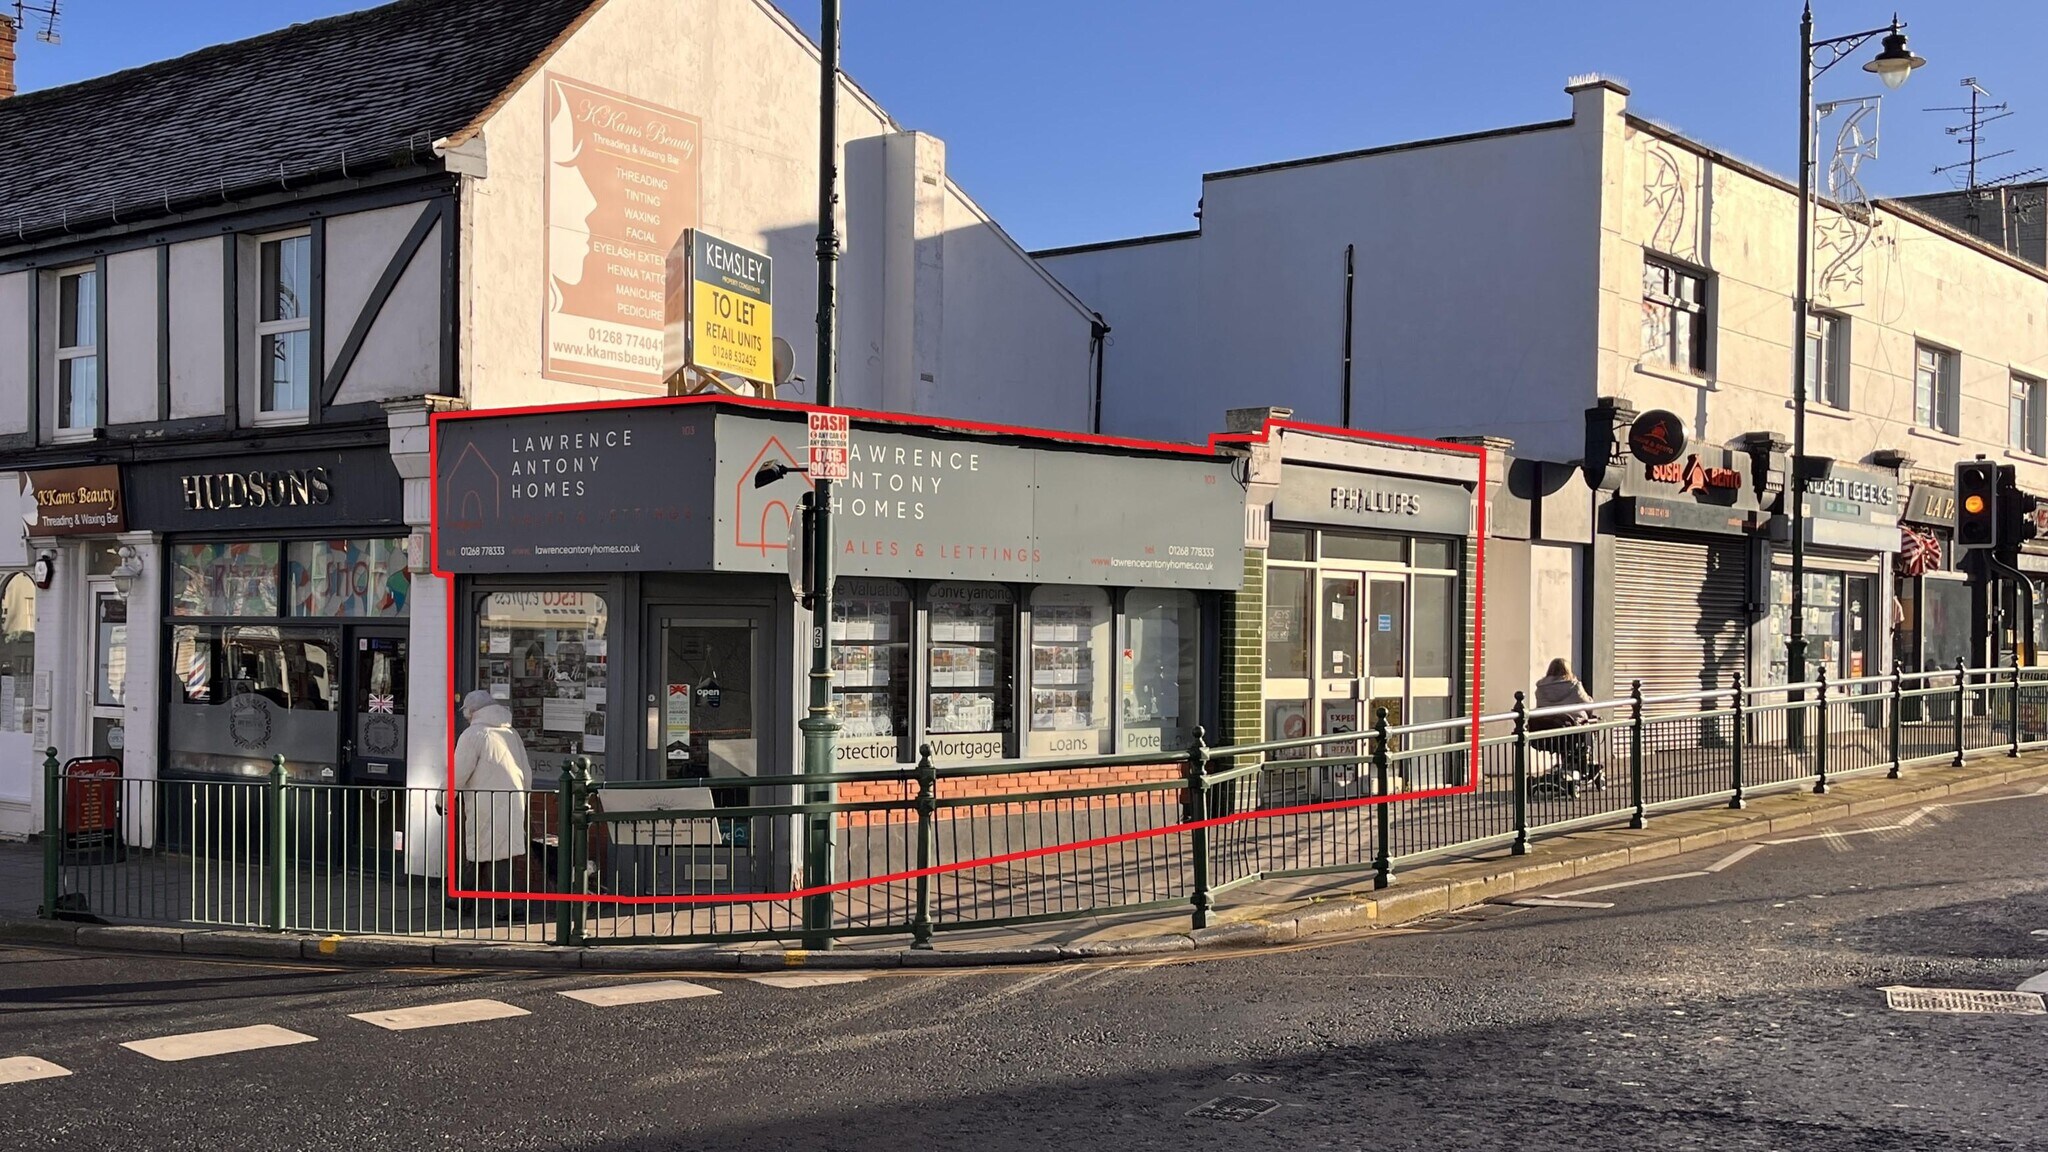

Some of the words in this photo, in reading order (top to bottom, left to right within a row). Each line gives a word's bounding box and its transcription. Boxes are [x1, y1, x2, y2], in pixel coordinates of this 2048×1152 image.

[576, 98, 642, 138] KKams
[646, 120, 694, 161] Beauty
[593, 132, 631, 153] Threading
[632, 143, 638, 153] &
[639, 146, 666, 165] Waxing
[667, 153, 679, 165] Bar
[615, 167, 669, 190] THREADING
[625, 188, 661, 207] TINTING
[624, 207, 660, 225] WAXING
[626, 227, 657, 243] FACIAL
[593, 241, 635, 260] EYELASH
[607, 263, 639, 280] HENNA
[706, 242, 763, 283] KEMSLEY
[616, 284, 663, 303] MANICURE
[617, 303, 663, 321] PEDICURE
[712, 291, 731, 318] TO
[736, 299, 755, 326] LET
[588, 327, 622, 345] 01268
[706, 321, 735, 344] RETAIL
[737, 330, 762, 352] UNITS
[712, 345, 732, 360] 01268
[734, 350, 757, 367] 532425
[810, 415, 847, 431] CASH
[511, 430, 632, 453] LAWRENCE
[815, 448, 842, 462] 07415
[849, 443, 979, 471] AWRENCE
[511, 456, 600, 476] ANTONY
[1652, 462, 1681, 482] SUSHI
[1711, 468, 1742, 489] BENTO
[181, 465, 331, 511] HUDSONS
[511, 481, 585, 499] HOMES
[1852, 481, 1893, 505] GEEKS
[38, 489, 75, 506] KKams
[77, 486, 115, 511] Beauty
[1925, 495, 1942, 517] LA
[831, 497, 925, 520] HOMES
[42, 515, 73, 528] Threading
[74, 514, 80, 525] &
[81, 513, 106, 527] Waxing
[106, 512, 119, 523] Bar
[461, 546, 480, 556] 01268
[535, 544, 640, 556] lawrenceantonyhomes.co.uk
[845, 540, 898, 556] ALES
[914, 543, 925, 557] &
[940, 545, 1041, 563] LETTINGS
[1168, 546, 1189, 556] 01268
[1190, 546, 1215, 557] 778333
[697, 688, 720, 698] open
[837, 742, 900, 760] otection
[930, 740, 1007, 759] Mortgages
[1049, 737, 1088, 751] Loans
